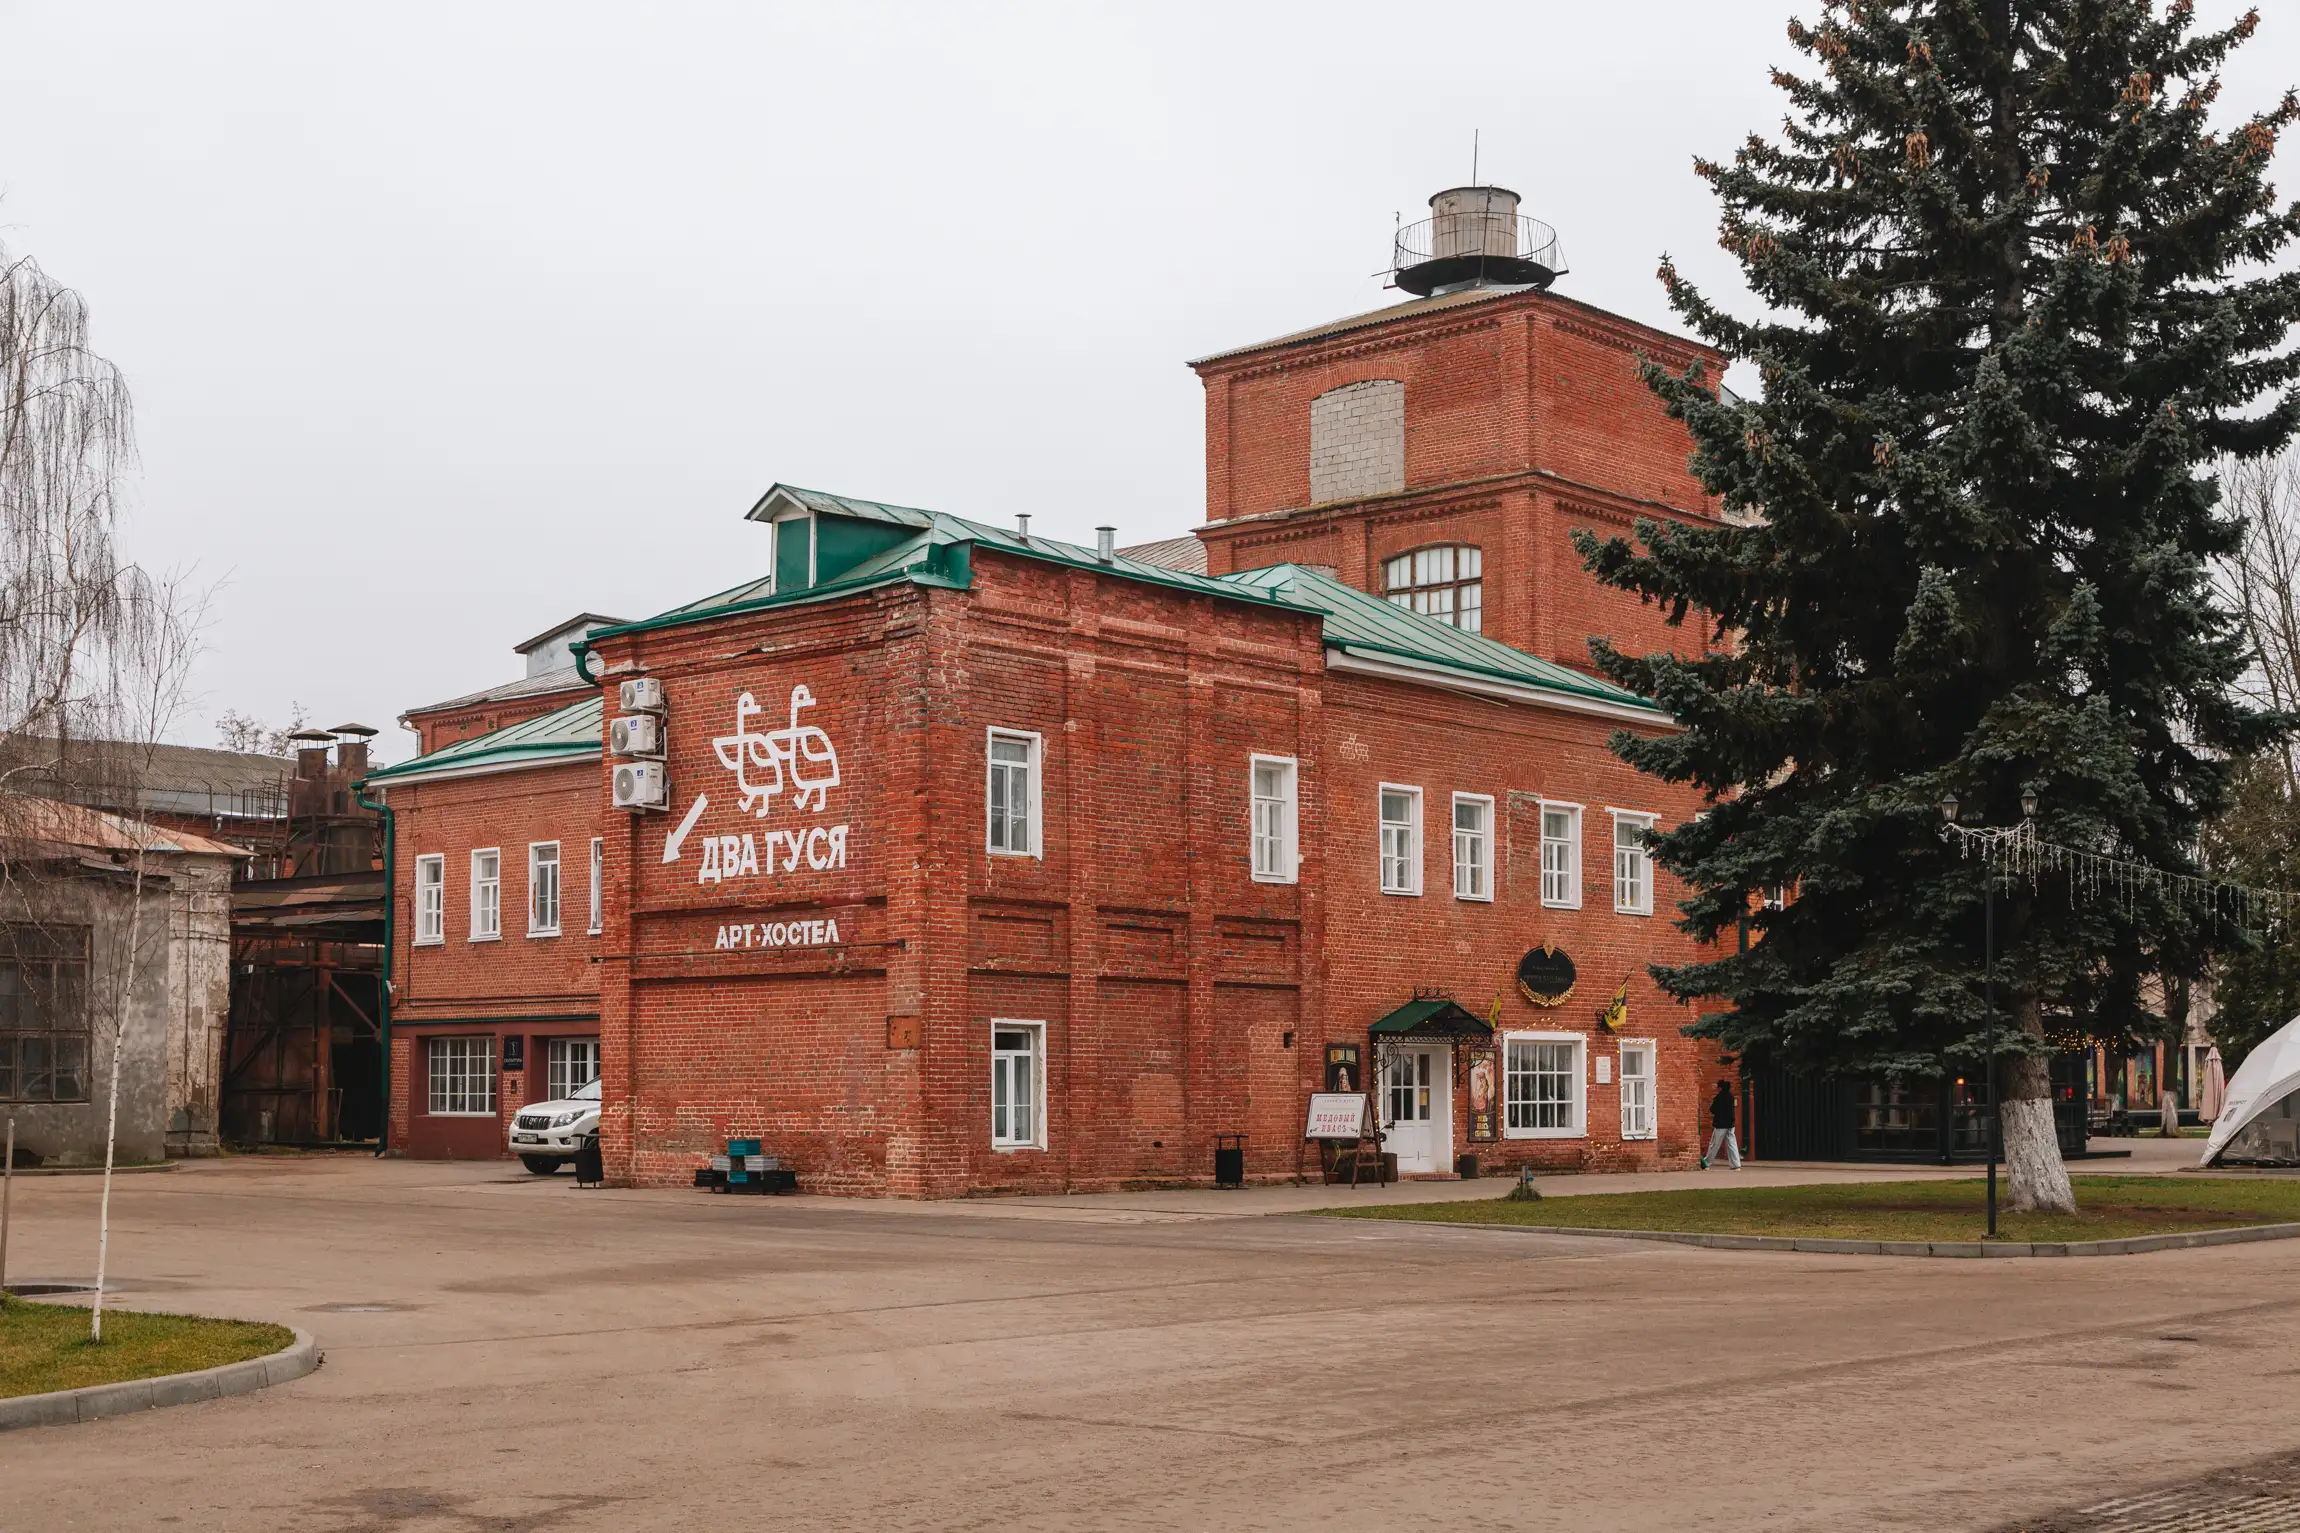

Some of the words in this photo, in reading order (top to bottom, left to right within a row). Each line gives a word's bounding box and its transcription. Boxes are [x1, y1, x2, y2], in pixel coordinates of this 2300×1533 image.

[699, 834, 759, 884] ДВА
[765, 825, 849, 873] ГУСЯ
[1316, 1112, 1355, 1122] МЕДОВЫЙ
